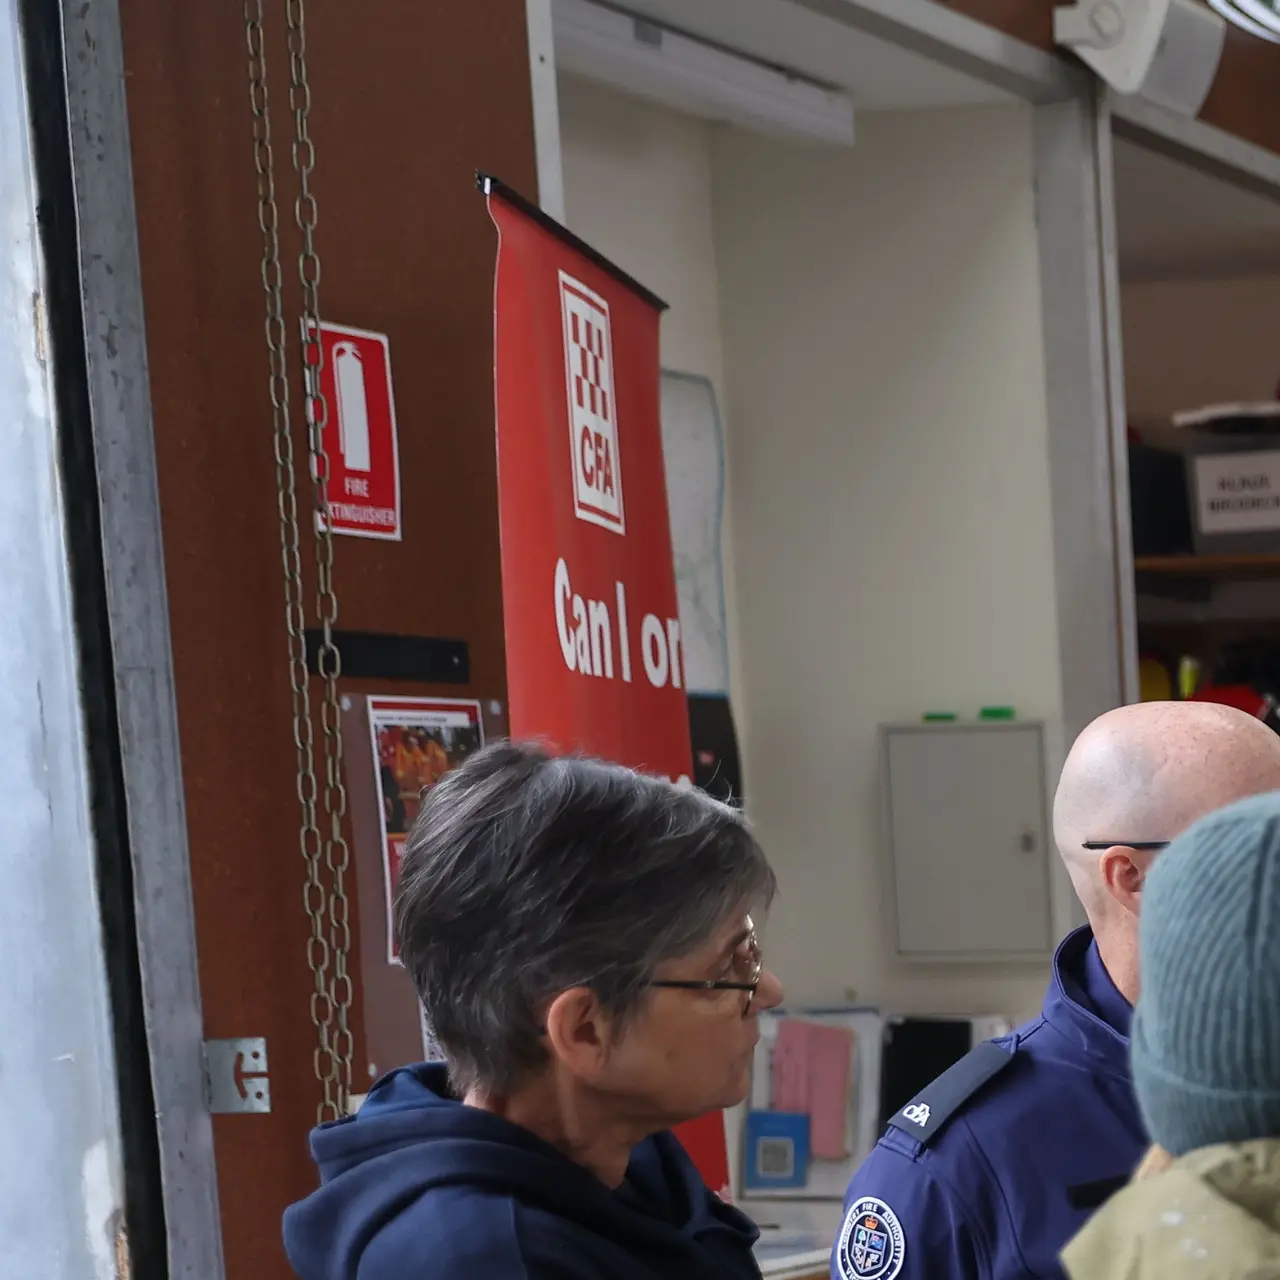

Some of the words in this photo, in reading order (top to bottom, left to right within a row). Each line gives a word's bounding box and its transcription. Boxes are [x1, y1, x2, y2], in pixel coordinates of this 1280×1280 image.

[344, 477, 370, 498] FIRE
[580, 425, 615, 499] CFA
[322, 501, 397, 527] XTINGUISHER
[554, 557, 614, 679] Can
[615, 581, 632, 683] I
[862, 1202, 879, 1212] FIRE
[882, 1211, 902, 1265] AUTHORITY
